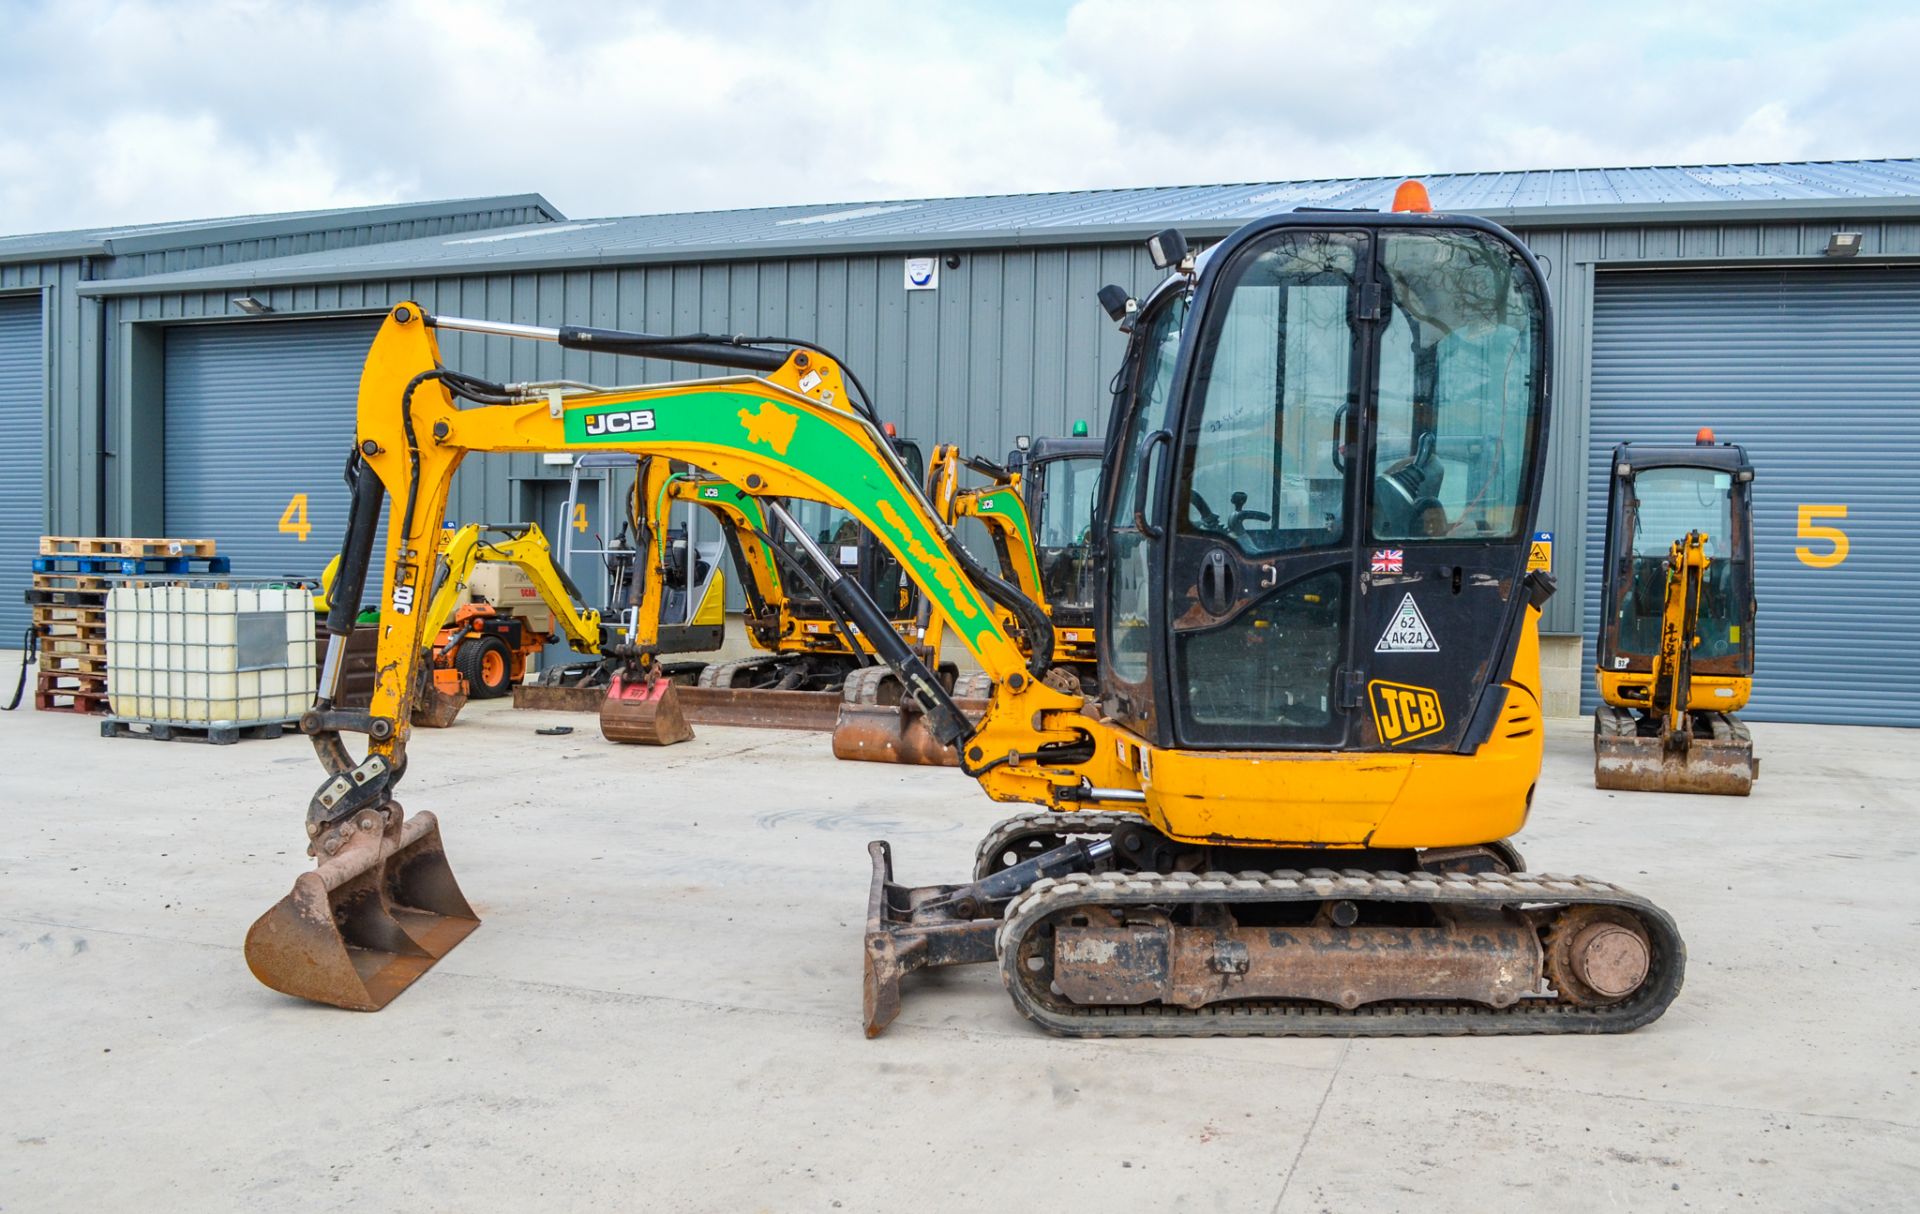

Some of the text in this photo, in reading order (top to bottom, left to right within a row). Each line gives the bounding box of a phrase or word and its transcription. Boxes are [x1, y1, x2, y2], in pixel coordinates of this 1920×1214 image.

[586, 410, 655, 434] JCB
[278, 493, 312, 542] 4
[572, 503, 588, 533] 4
[1795, 504, 1850, 568] 5
[1392, 632, 1423, 644] AK2A
[1400, 617, 1416, 629] 62
[1380, 687, 1438, 739] JCB
